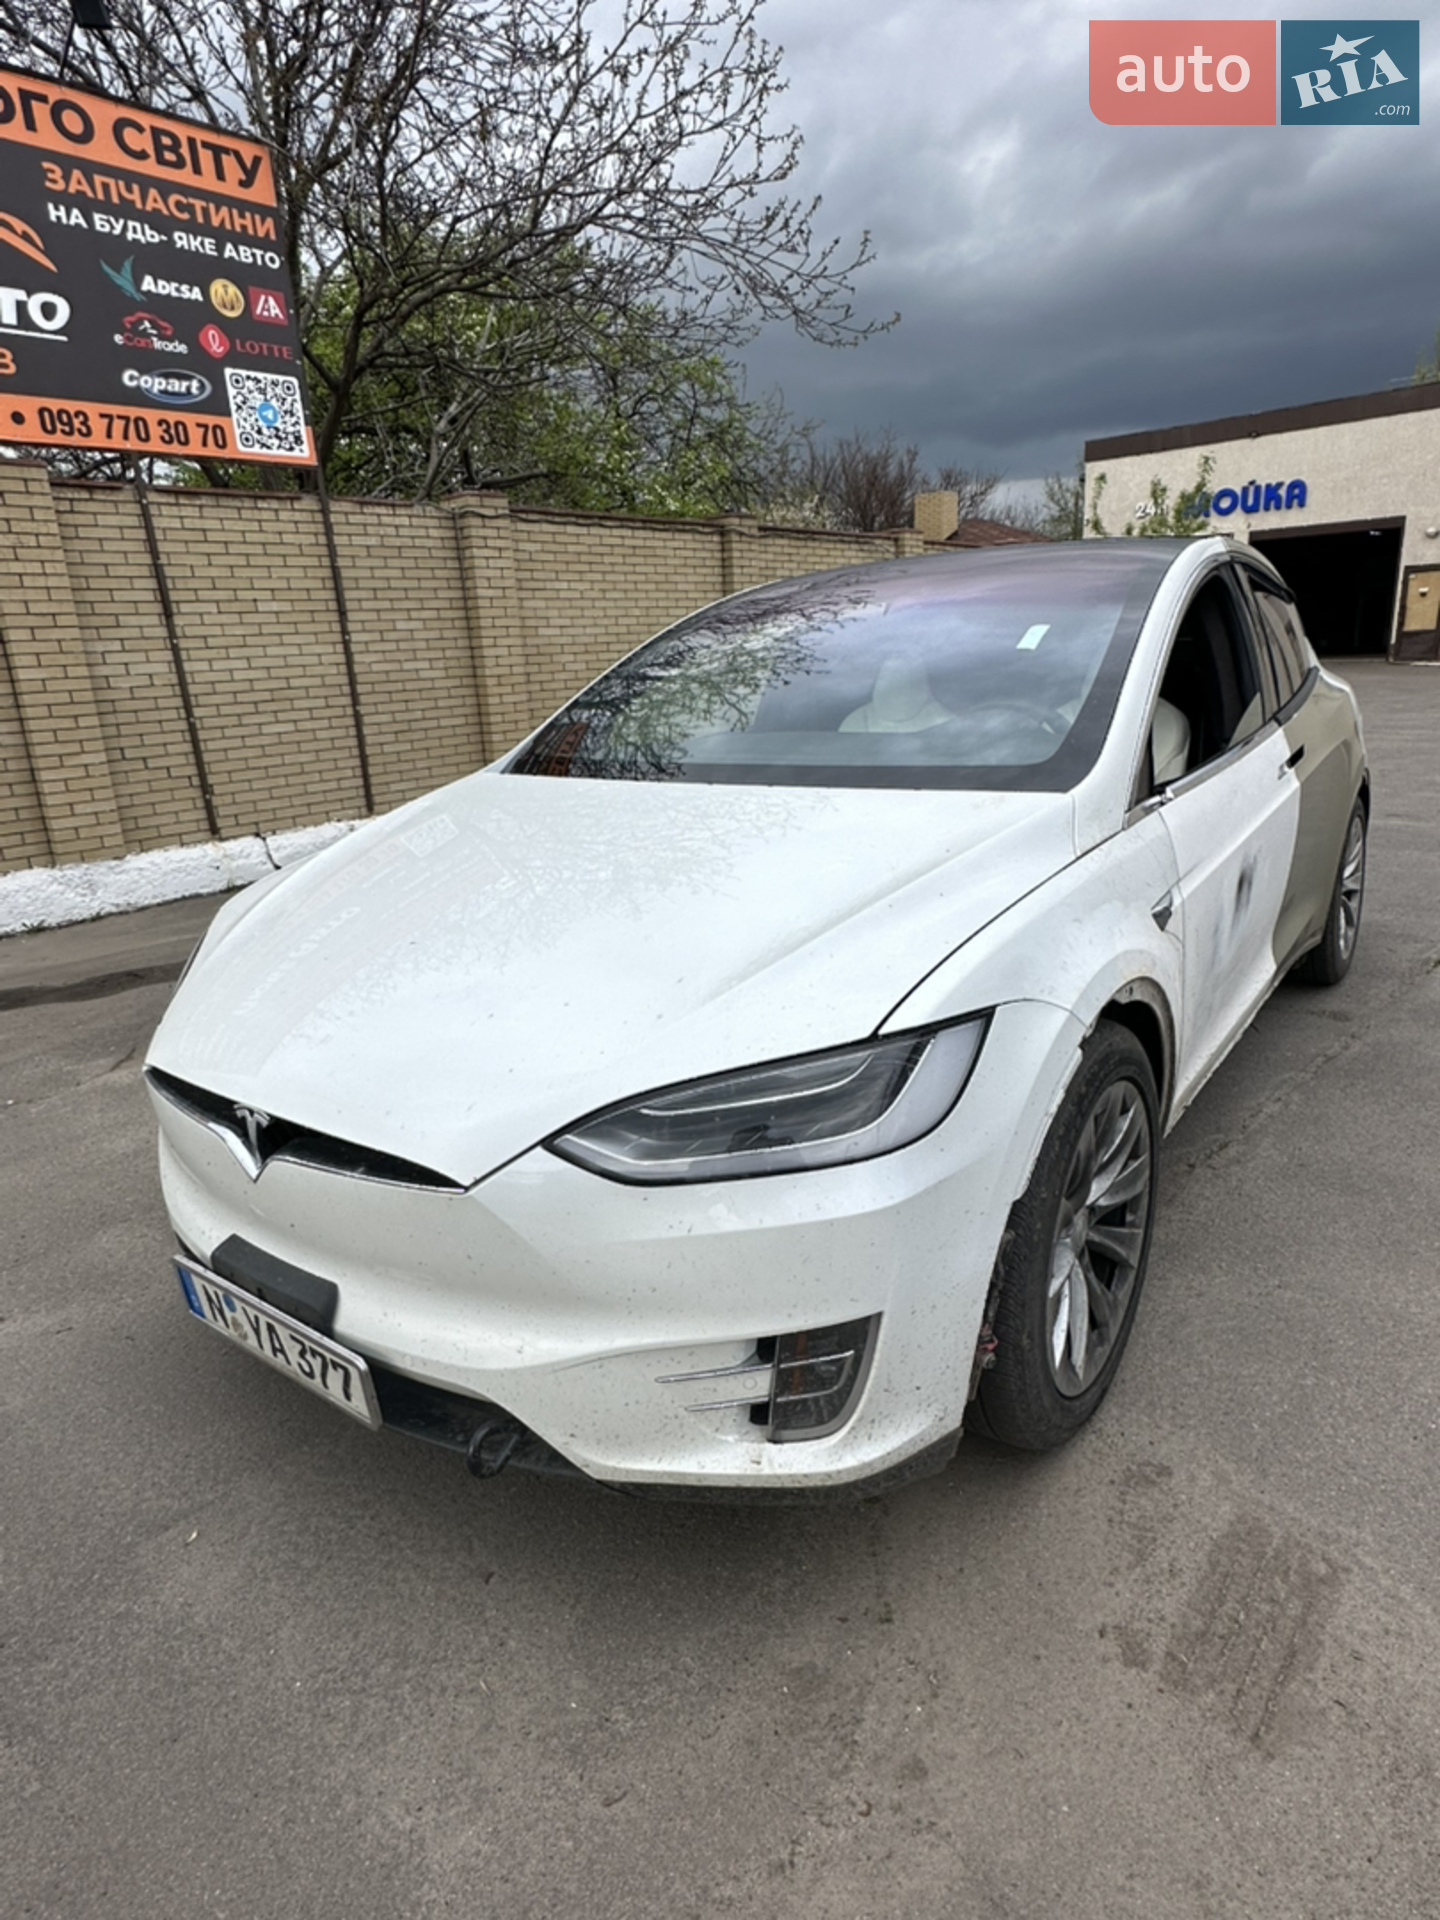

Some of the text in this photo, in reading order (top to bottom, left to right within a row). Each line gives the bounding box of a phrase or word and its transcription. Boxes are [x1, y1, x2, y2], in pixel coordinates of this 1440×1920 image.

[112, 116, 263, 189] СВІТУ
[41, 161, 277, 241] ЗАПЧАСТИНИ
[47, 202, 281, 269] НА БУДЬ- ЯКЕ АВТО
[141, 274, 203, 302] ADESA
[236, 339, 293, 360] LOTTE
[122, 368, 200, 395] Copart
[37, 406, 228, 450] 093 770 30 70
[202, 1283, 230, 1330] N
[290, 1333, 353, 1403] 377
